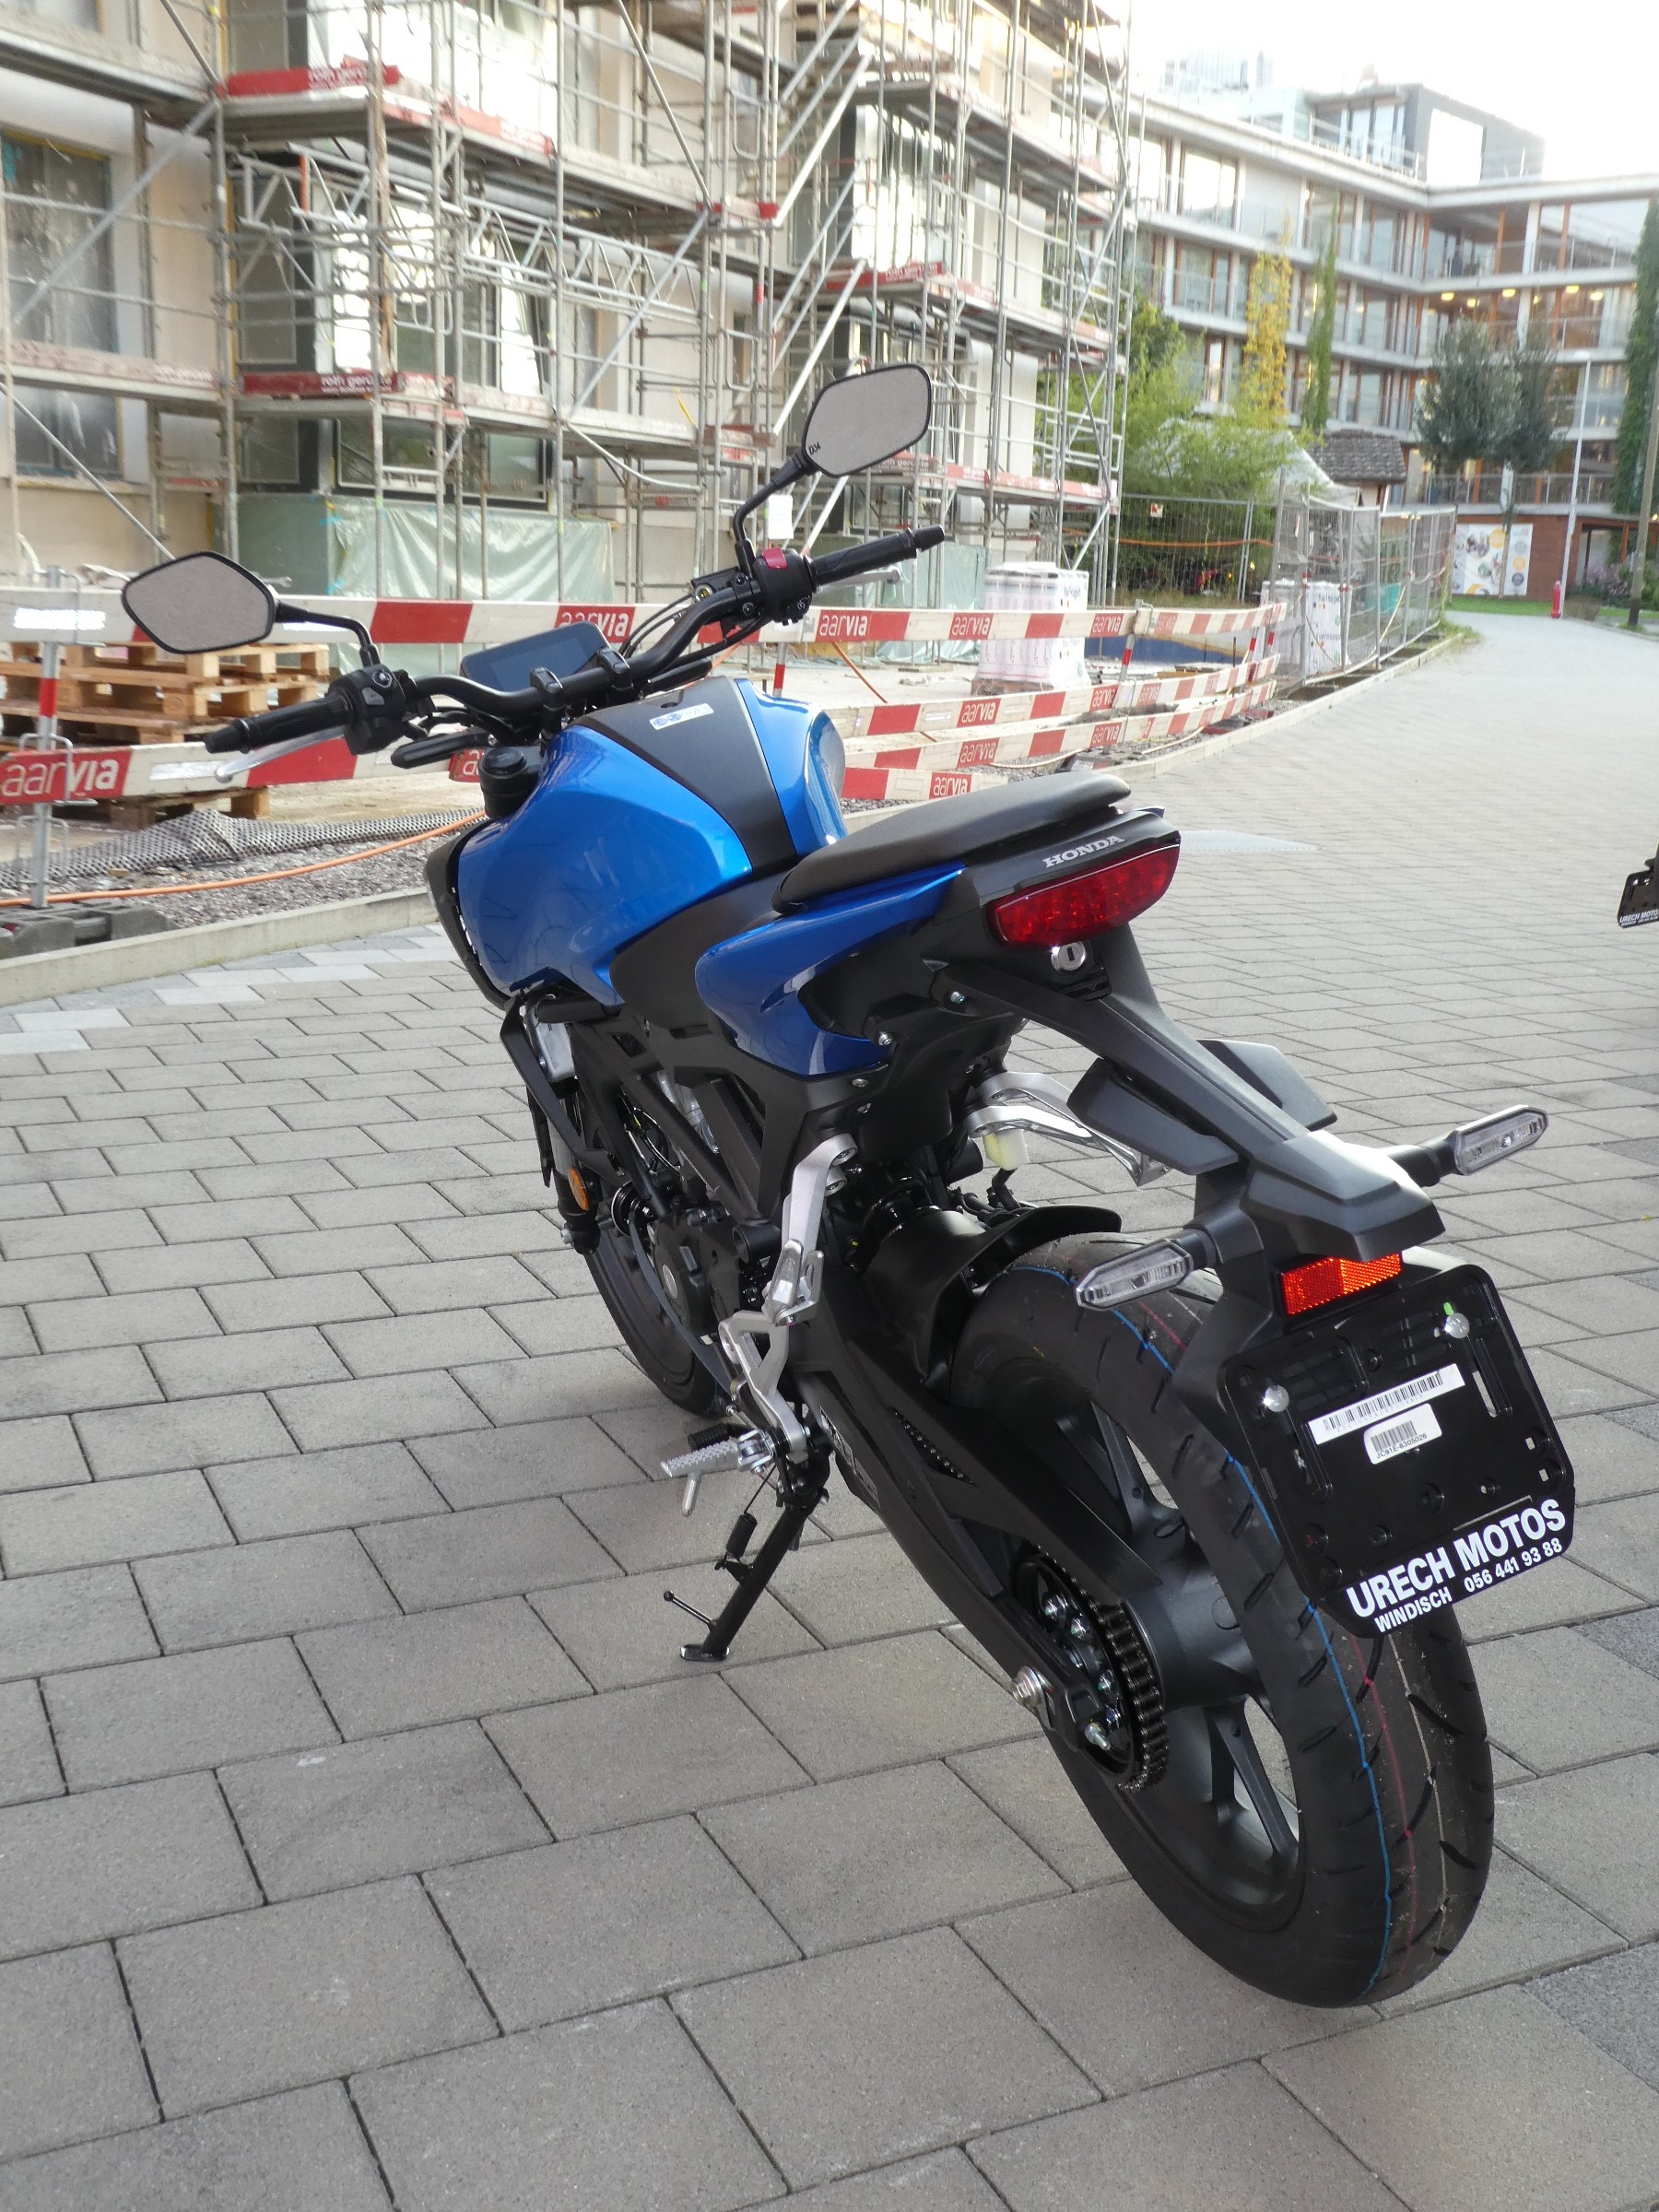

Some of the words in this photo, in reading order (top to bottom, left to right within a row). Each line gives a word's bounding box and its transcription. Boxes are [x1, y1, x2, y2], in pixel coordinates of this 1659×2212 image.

[819, 615, 868, 636] aarvia
[951, 617, 991, 636] aarvia
[1092, 616, 1122, 633] aarvia
[961, 701, 996, 724] aarvia
[1091, 725, 1119, 744] aarvia
[959, 742, 996, 763] aarvia
[2, 759, 119, 796] aarvia
[934, 776, 968, 796] aarvia
[1043, 835, 1125, 868] HONDA
[1640, 909, 1659, 919] MOTO
[1347, 1547, 1456, 1618] URECH
[1453, 1499, 1566, 1571] MOTOS
[1374, 1587, 1453, 1632] WINDISCH
[1464, 1569, 1493, 1593] 056
[1495, 1557, 1520, 1578] 441
[1521, 1547, 1542, 1567] 93
[1542, 1537, 1562, 1556] 88
